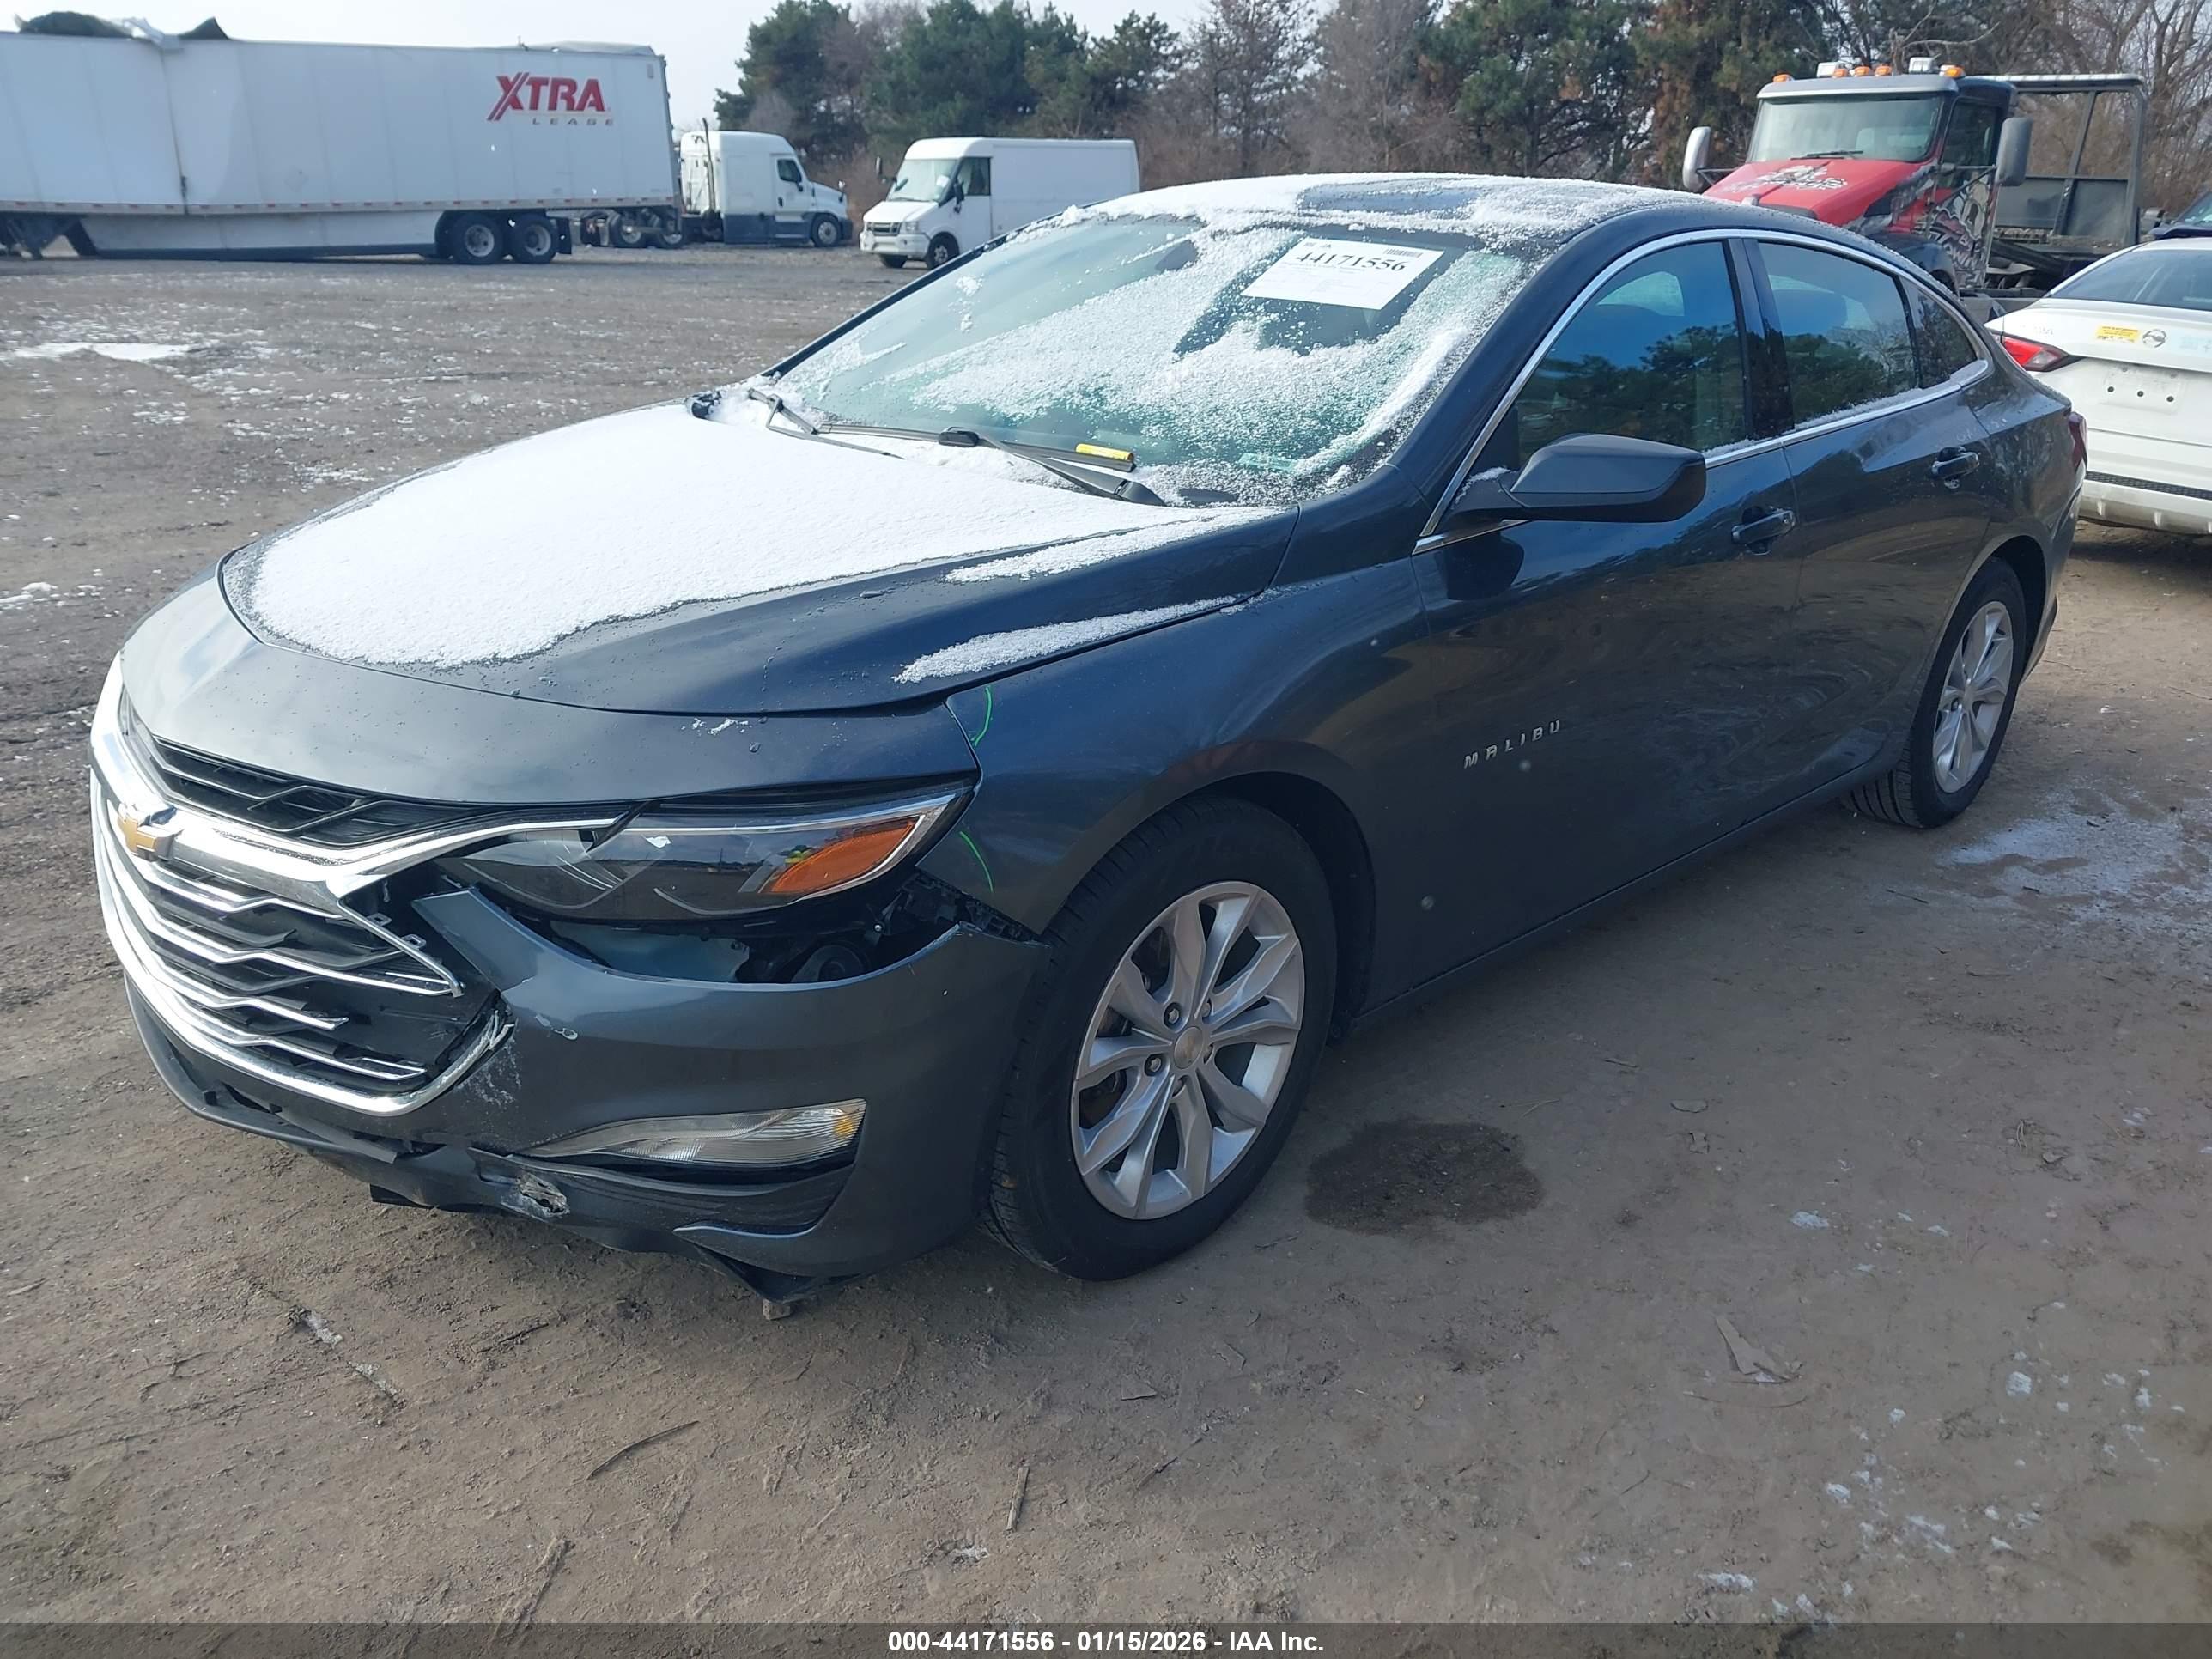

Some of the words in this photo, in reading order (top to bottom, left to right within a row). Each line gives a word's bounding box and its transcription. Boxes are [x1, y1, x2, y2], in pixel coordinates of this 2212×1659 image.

[486, 72, 605, 121] XTRA
[532, 118, 614, 126] LEASE
[1296, 252, 1410, 272] 44171556
[1462, 720, 1561, 769] MALIBU
